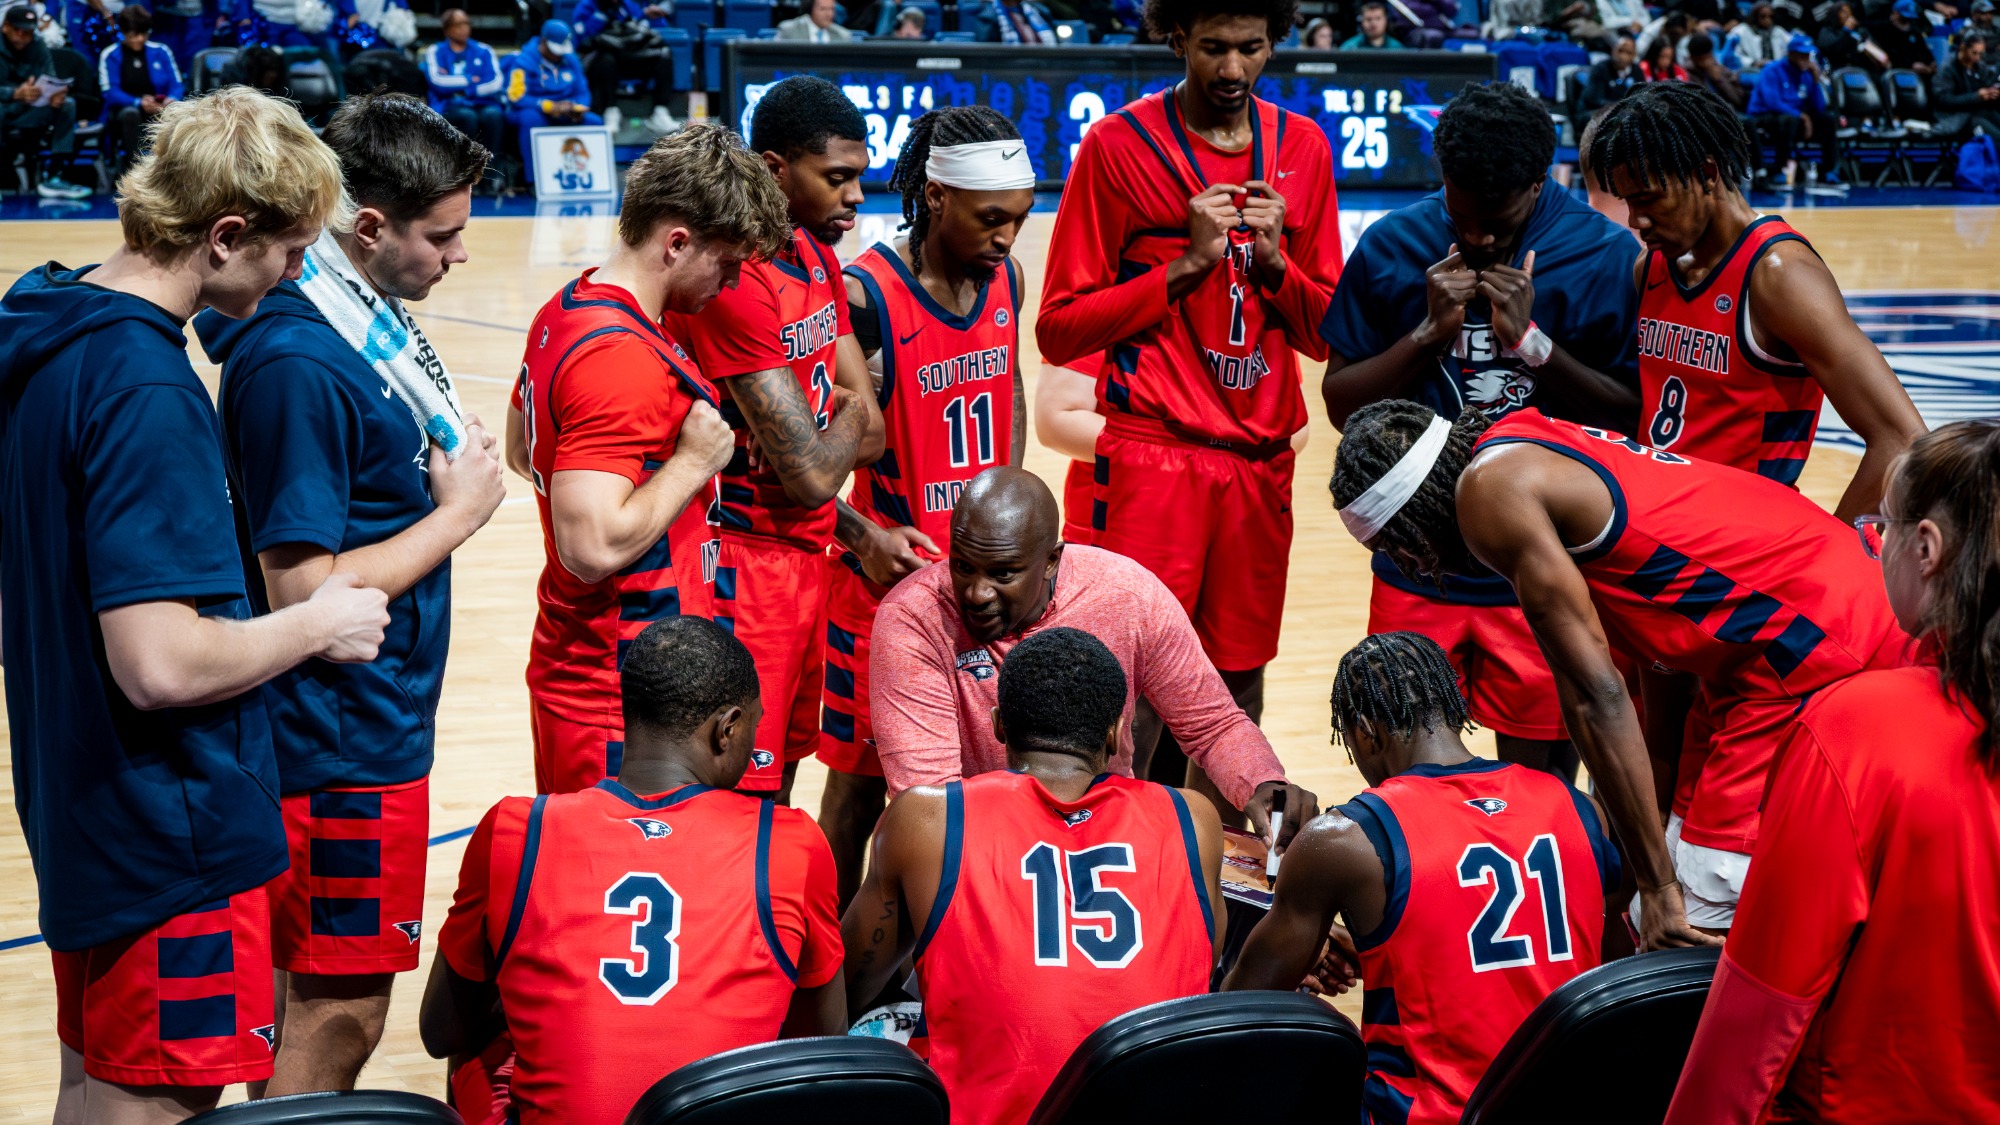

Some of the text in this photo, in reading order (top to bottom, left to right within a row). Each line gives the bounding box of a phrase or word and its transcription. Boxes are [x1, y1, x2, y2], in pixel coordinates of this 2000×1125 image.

[876, 85, 890, 110] 3
[903, 85, 915, 109] F
[919, 85, 934, 110] 4
[1352, 89, 1365, 113] 3
[1376, 89, 1388, 113] F
[1389, 89, 1402, 113] 2
[1341, 116, 1389, 169] 25
[1229, 282, 1246, 346] 1
[1639, 317, 1730, 374] SOUTHERN
[811, 361, 833, 432] 2
[917, 345, 1008, 398] SOUTHERN
[943, 391, 994, 468] 11
[1648, 375, 1688, 450] 8
[1021, 840, 1143, 969] 15
[1456, 833, 1573, 973] 21
[599, 871, 683, 1006] 3
